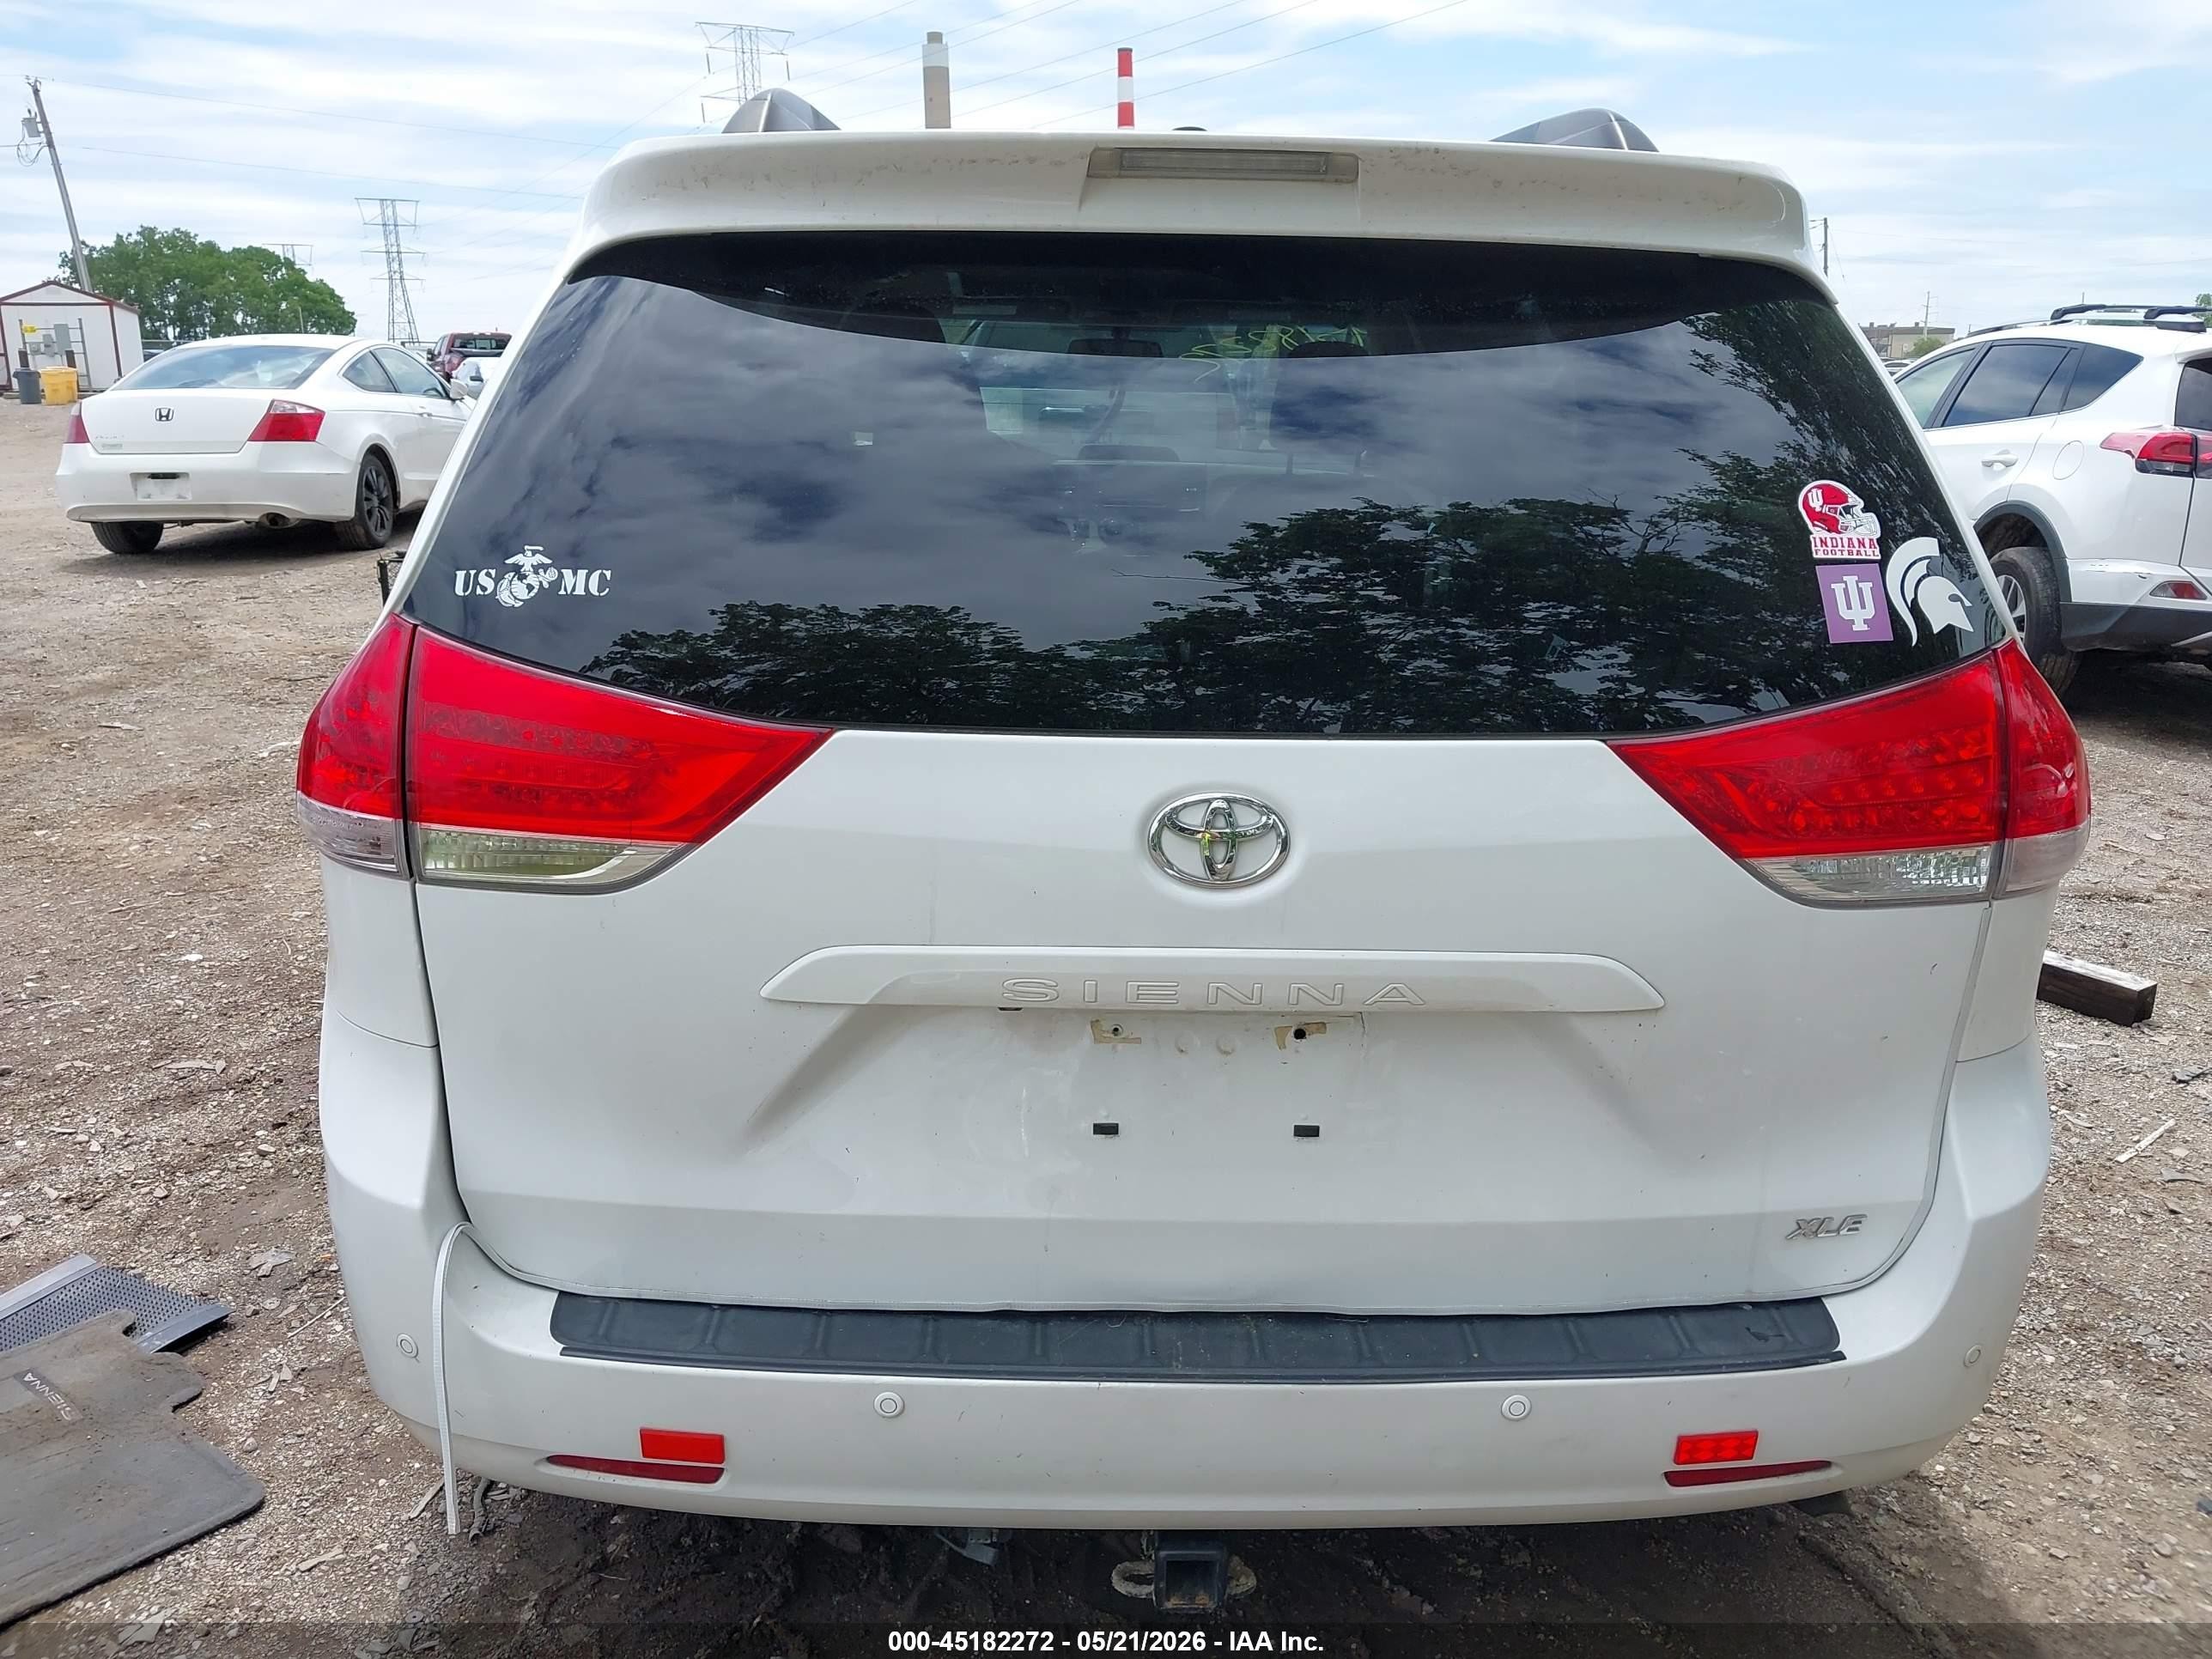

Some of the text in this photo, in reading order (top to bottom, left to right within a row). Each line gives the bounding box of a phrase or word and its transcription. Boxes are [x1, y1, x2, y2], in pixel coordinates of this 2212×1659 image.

[1813, 536, 1878, 550] INDIANA
[1814, 549, 1880, 557] FOOTBALL
[454, 568, 611, 597] US MC
[1001, 977, 1427, 1006] SIENNA
[1785, 1214, 1868, 1240] XLE
